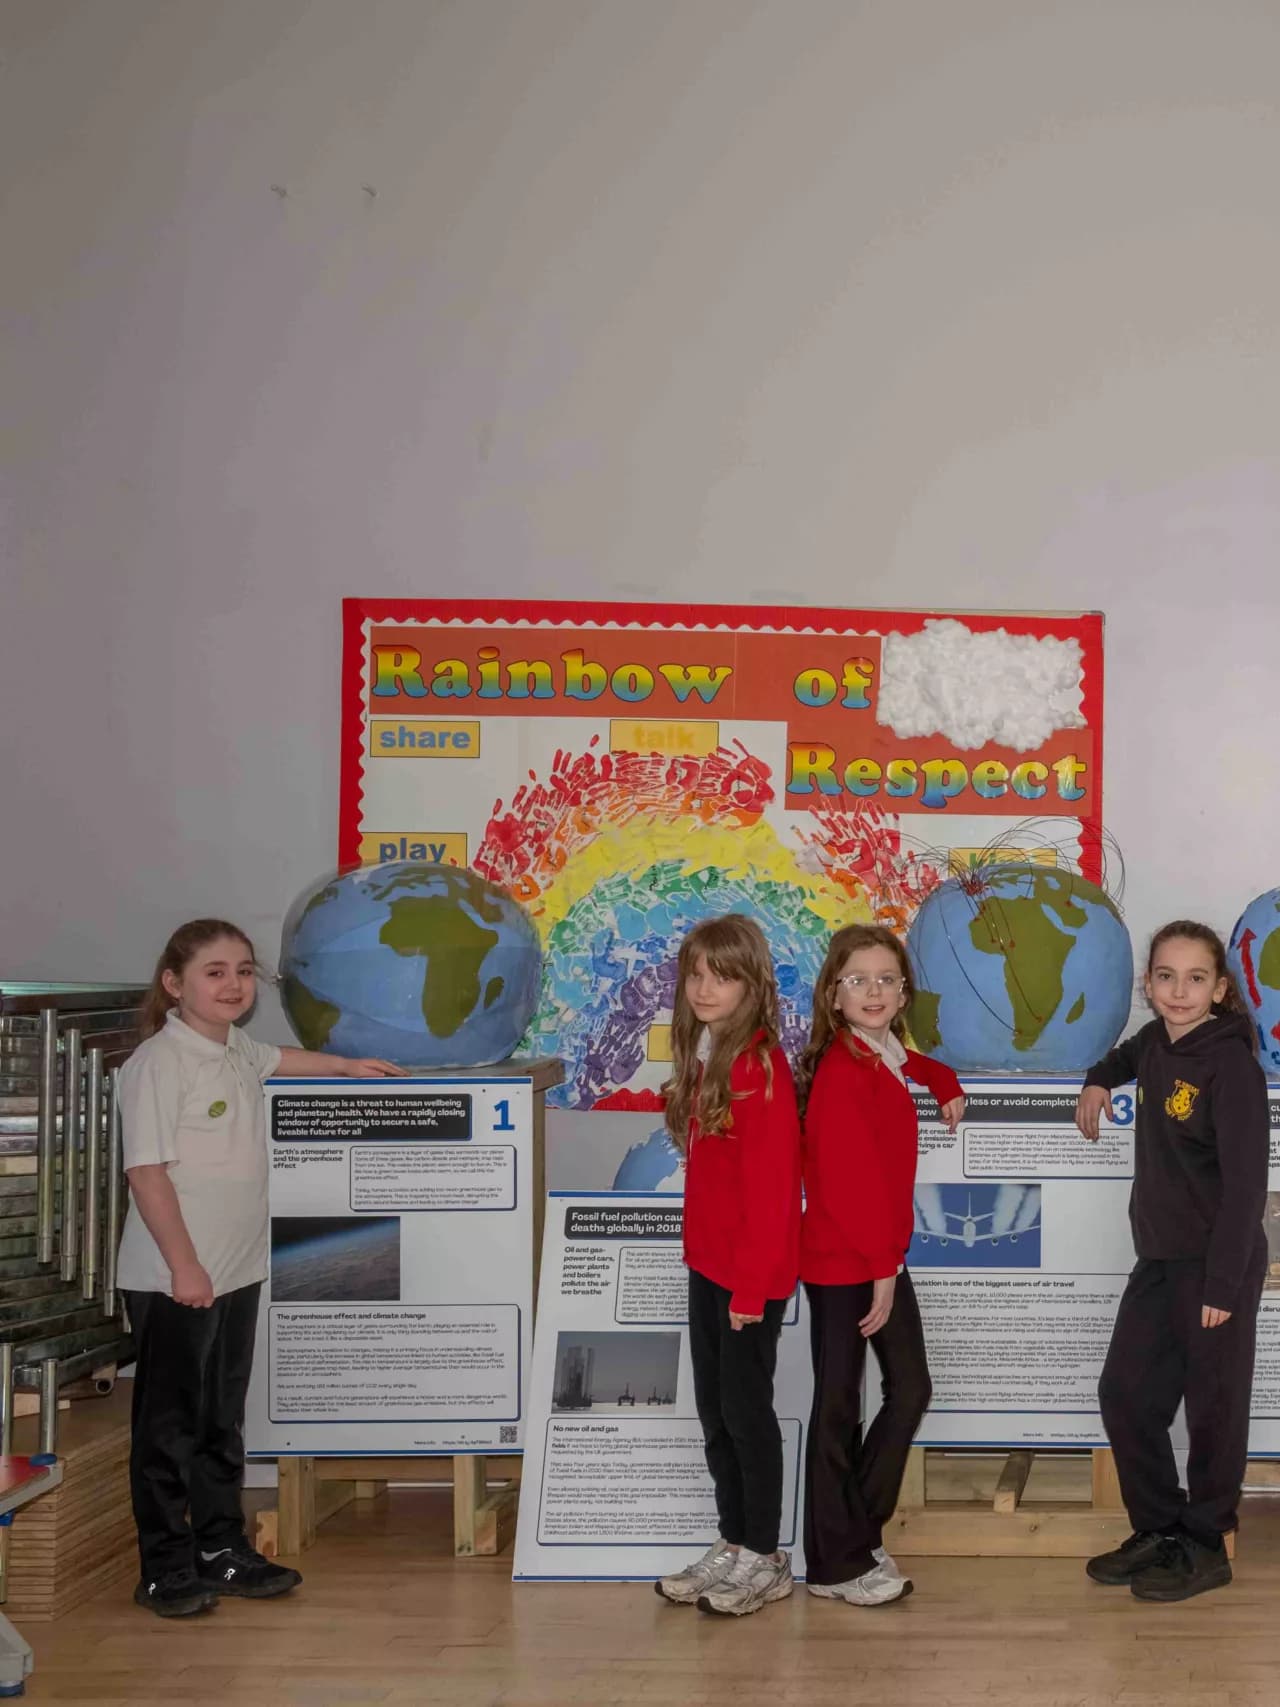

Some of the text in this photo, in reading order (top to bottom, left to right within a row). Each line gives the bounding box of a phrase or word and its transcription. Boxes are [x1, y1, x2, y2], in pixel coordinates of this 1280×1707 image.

[371, 644, 876, 710] Rainbow of
[379, 725, 471, 750] share
[631, 724, 695, 750] talk
[786, 741, 1087, 809] Respect
[380, 837, 447, 863] play
[311, 1100, 340, 1108] change
[424, 1099, 462, 1107] wellbeing
[970, 1097, 989, 1105] less
[1031, 1098, 1078, 1107] completel
[294, 1110, 335, 1118] planetary
[408, 1109, 437, 1117] rapidly
[437, 1109, 466, 1117] closing
[1111, 1094, 1134, 1125] 3
[492, 1099, 515, 1131] 1
[321, 1119, 370, 1127] opportunity
[572, 1212, 599, 1220] Fossil
[601, 1212, 620, 1220] fuel
[621, 1212, 663, 1222] pollution
[571, 1224, 682, 1234] deaths globally in 2018
[563, 1255, 596, 1263] powered
[587, 1263, 610, 1271] plants
